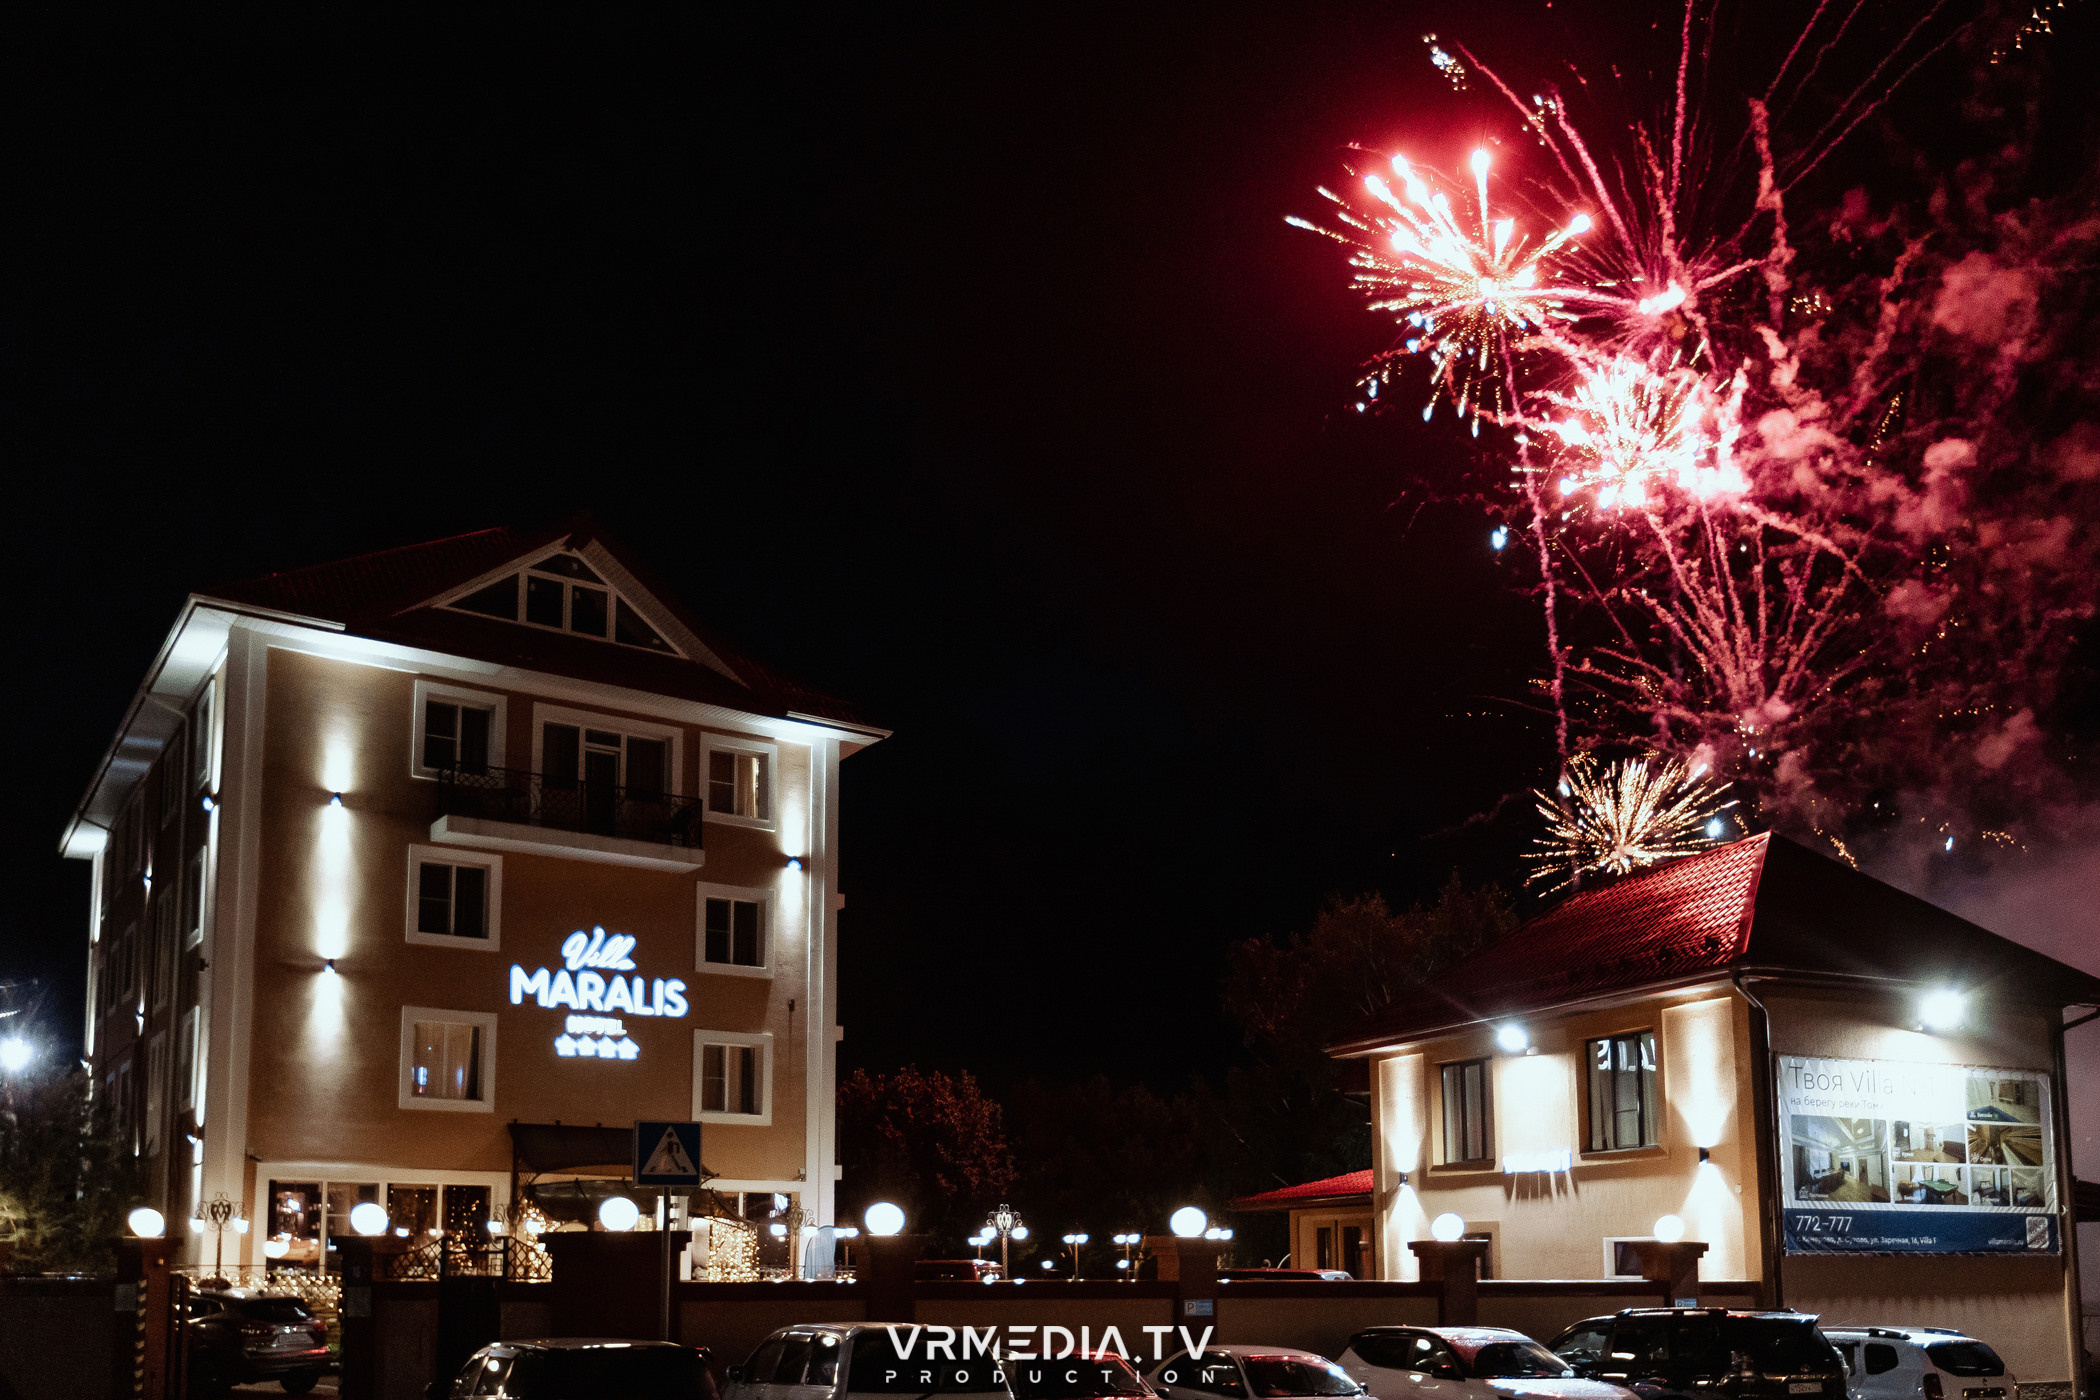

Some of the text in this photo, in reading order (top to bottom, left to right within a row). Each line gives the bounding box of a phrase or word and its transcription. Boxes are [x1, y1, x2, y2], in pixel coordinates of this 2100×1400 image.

[509, 963, 689, 1018] MARALIS
[1789, 1065, 1843, 1091] Твоя
[1850, 1069, 1893, 1095] Villa
[1790, 1096, 1883, 1111] на берегу реки Том
[1796, 1215, 1853, 1232] 772-777
